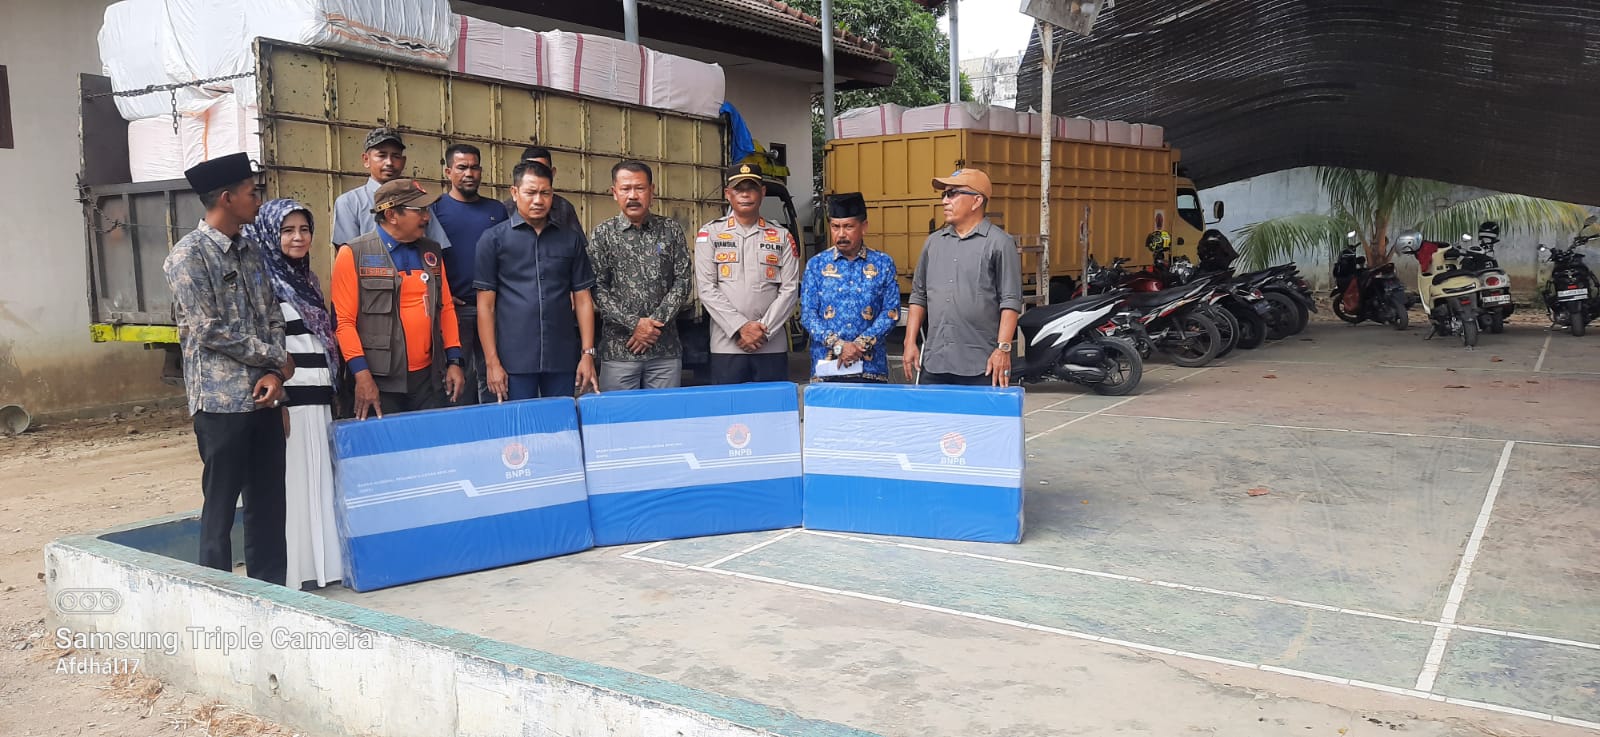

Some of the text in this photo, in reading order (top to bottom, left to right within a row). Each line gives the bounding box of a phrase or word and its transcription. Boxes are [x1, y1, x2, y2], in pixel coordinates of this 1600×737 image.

[760, 243, 783, 251] POLRI
[728, 449, 752, 457] BNPB
[940, 456, 966, 465] BNPB
[505, 468, 531, 479] BNPB
